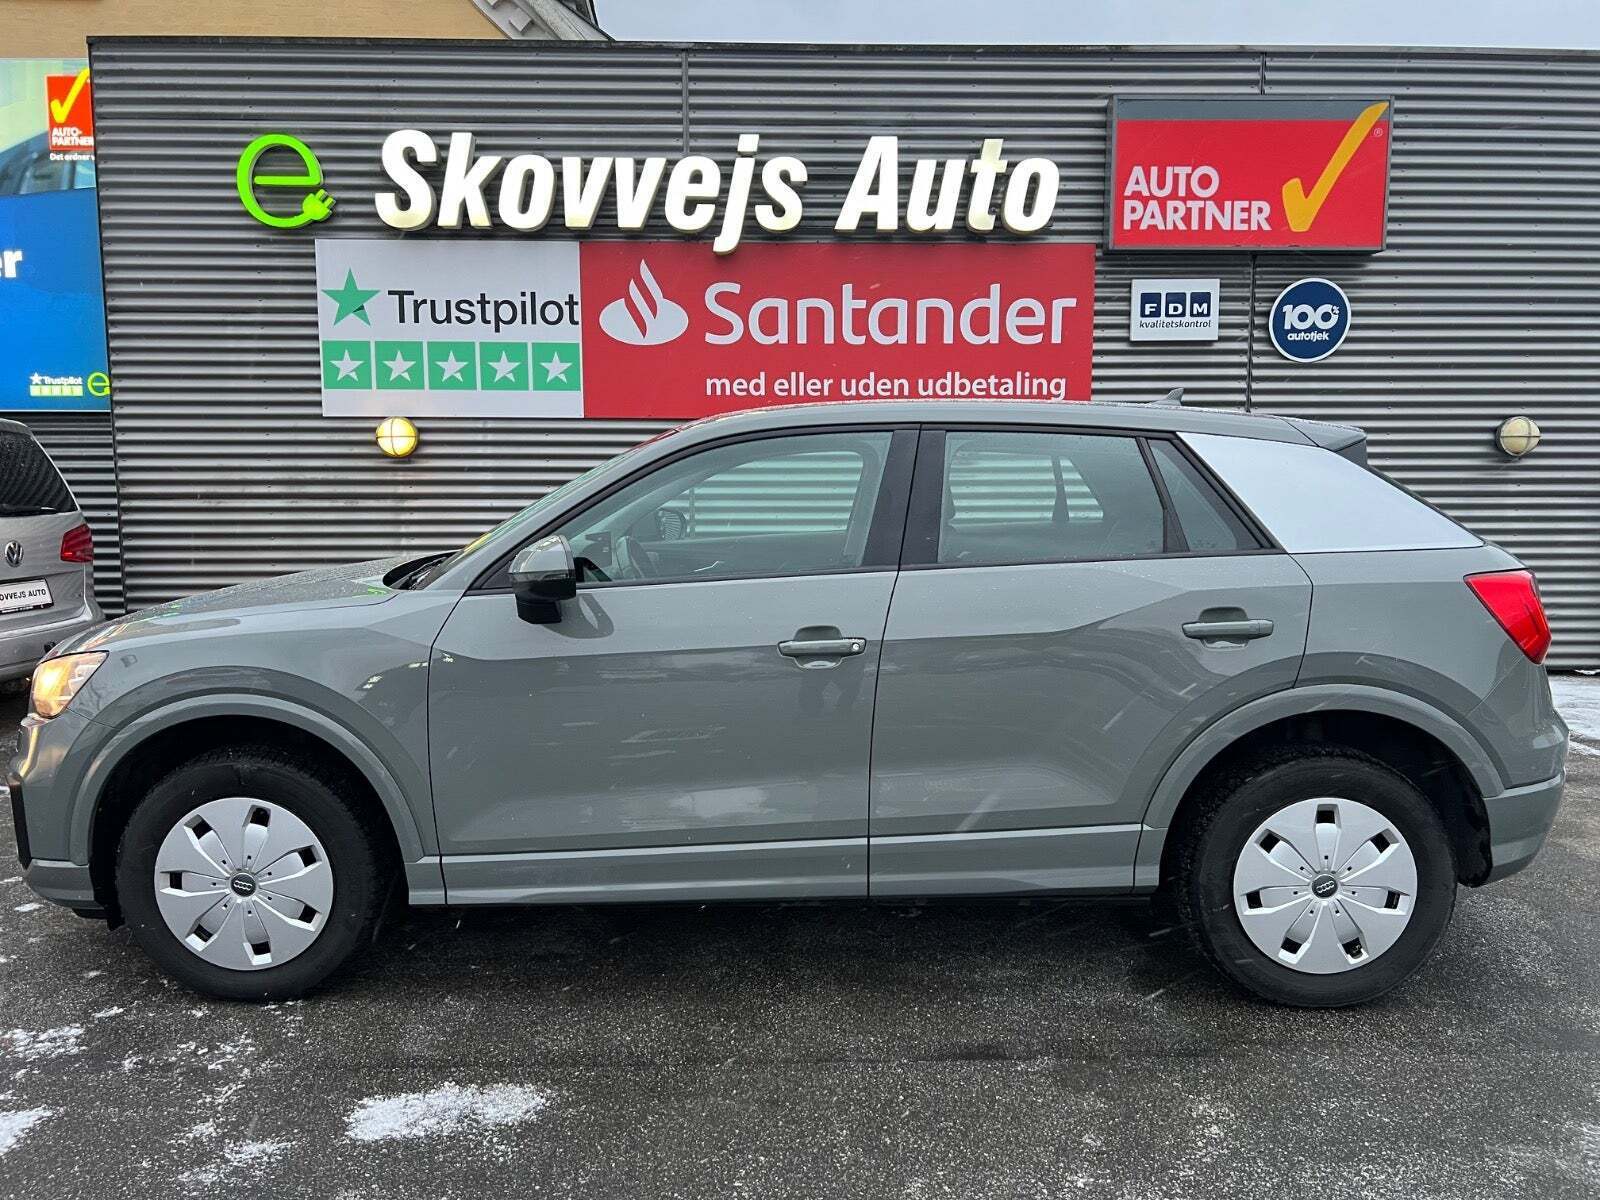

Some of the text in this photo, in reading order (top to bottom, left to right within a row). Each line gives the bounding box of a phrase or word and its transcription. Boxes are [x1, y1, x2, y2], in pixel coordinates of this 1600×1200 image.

[52, 127, 82, 137] AUTO-
[374, 129, 808, 255] Skovvejs
[835, 135, 1061, 234] Auto
[1123, 165, 1220, 198] AUTO
[1122, 199, 1272, 231] PARTNER
[387, 289, 580, 333] Trustpilot
[704, 281, 1077, 345] Santander
[1140, 320, 1212, 329] kvalitetskontrol
[1287, 331, 1330, 342] autotjek
[44, 375, 83, 386] Trustpilot
[705, 371, 1067, 401] med eller uden udbetaling
[28, 588, 47, 597] AUTO
